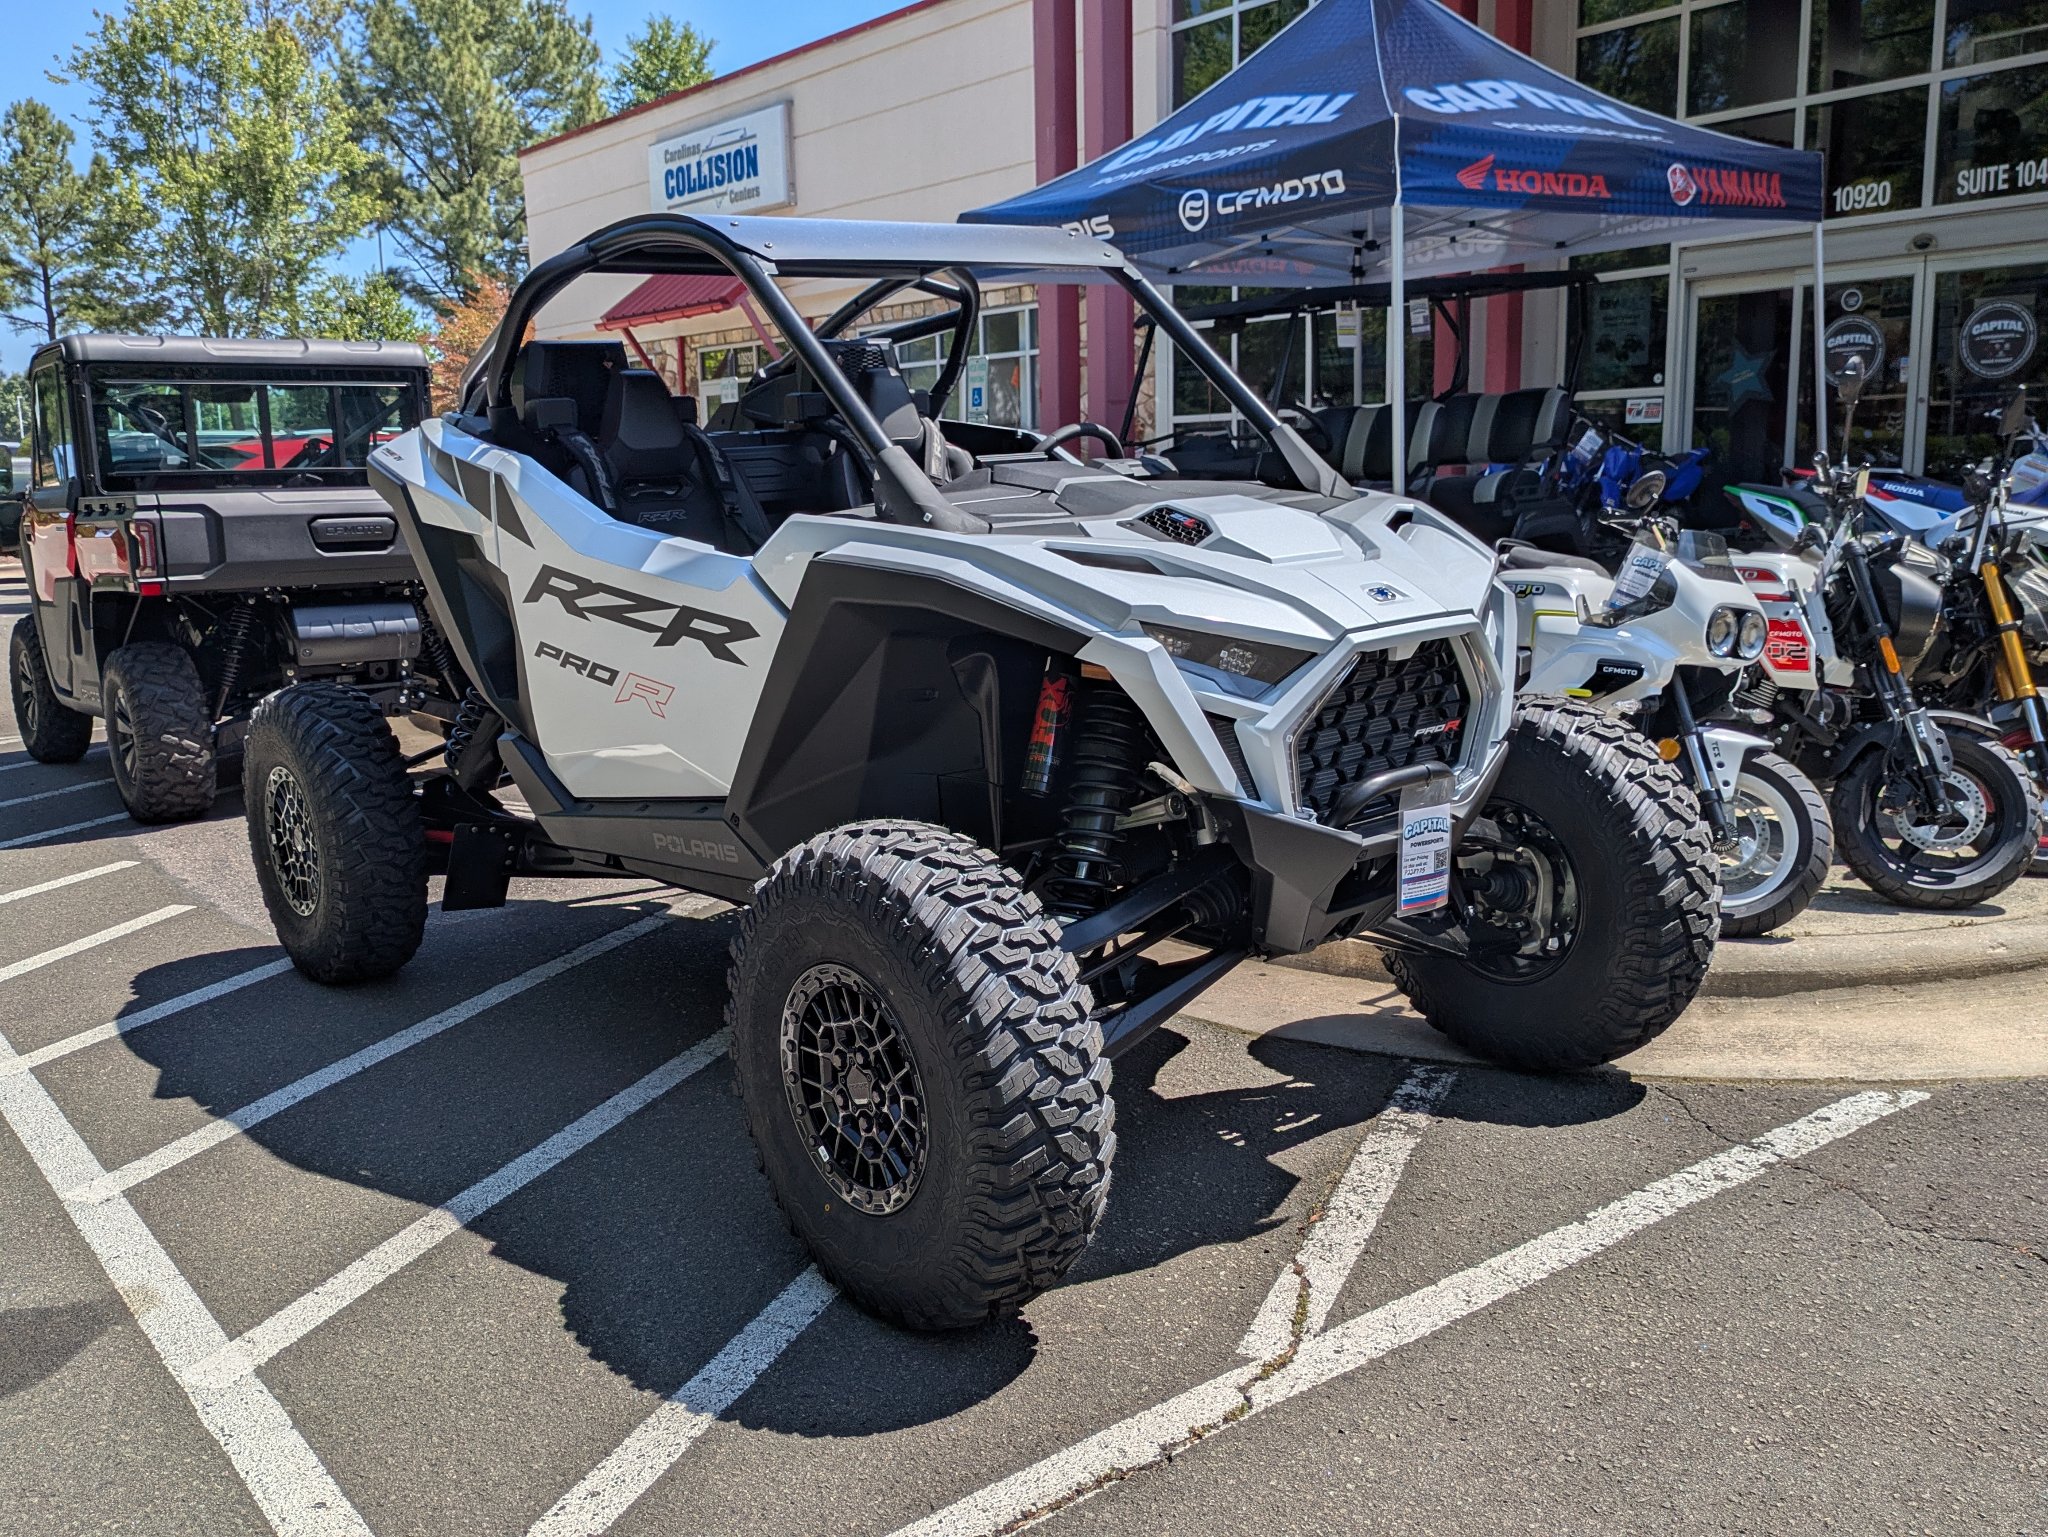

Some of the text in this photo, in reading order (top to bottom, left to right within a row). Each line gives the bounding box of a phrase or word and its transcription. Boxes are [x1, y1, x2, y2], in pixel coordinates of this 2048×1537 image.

[1405, 80, 1668, 133] CAPITAL
[1098, 92, 1358, 174] CAPITAL
[664, 143, 701, 164] Carolinas
[1088, 139, 1278, 188] POWERSPORTS
[664, 144, 759, 200] COLLISION
[1494, 169, 1612, 198] HONDA
[1956, 164, 2010, 196] SUITE
[729, 185, 761, 204] Centers
[1217, 169, 1347, 215] CFMOTO
[1692, 167, 1786, 208] YAMAHA
[1833, 181, 1892, 212] 10920
[1826, 333, 1875, 348] CAPITAL
[1971, 320, 2025, 335] CAPITAL
[1883, 482, 1924, 498] HONDA
[638, 508, 688, 524] RZR
[522, 564, 761, 668] RZR
[1769, 630, 1803, 638] CFMOTO
[1767, 641, 1807, 660] 02
[533, 640, 675, 719] PRO R
[1602, 665, 1638, 676] CFMOTO
[1403, 816, 1449, 840] CAPITAL
[1410, 837, 1444, 848] POWERSPORTS
[652, 832, 739, 863] POLARIS
